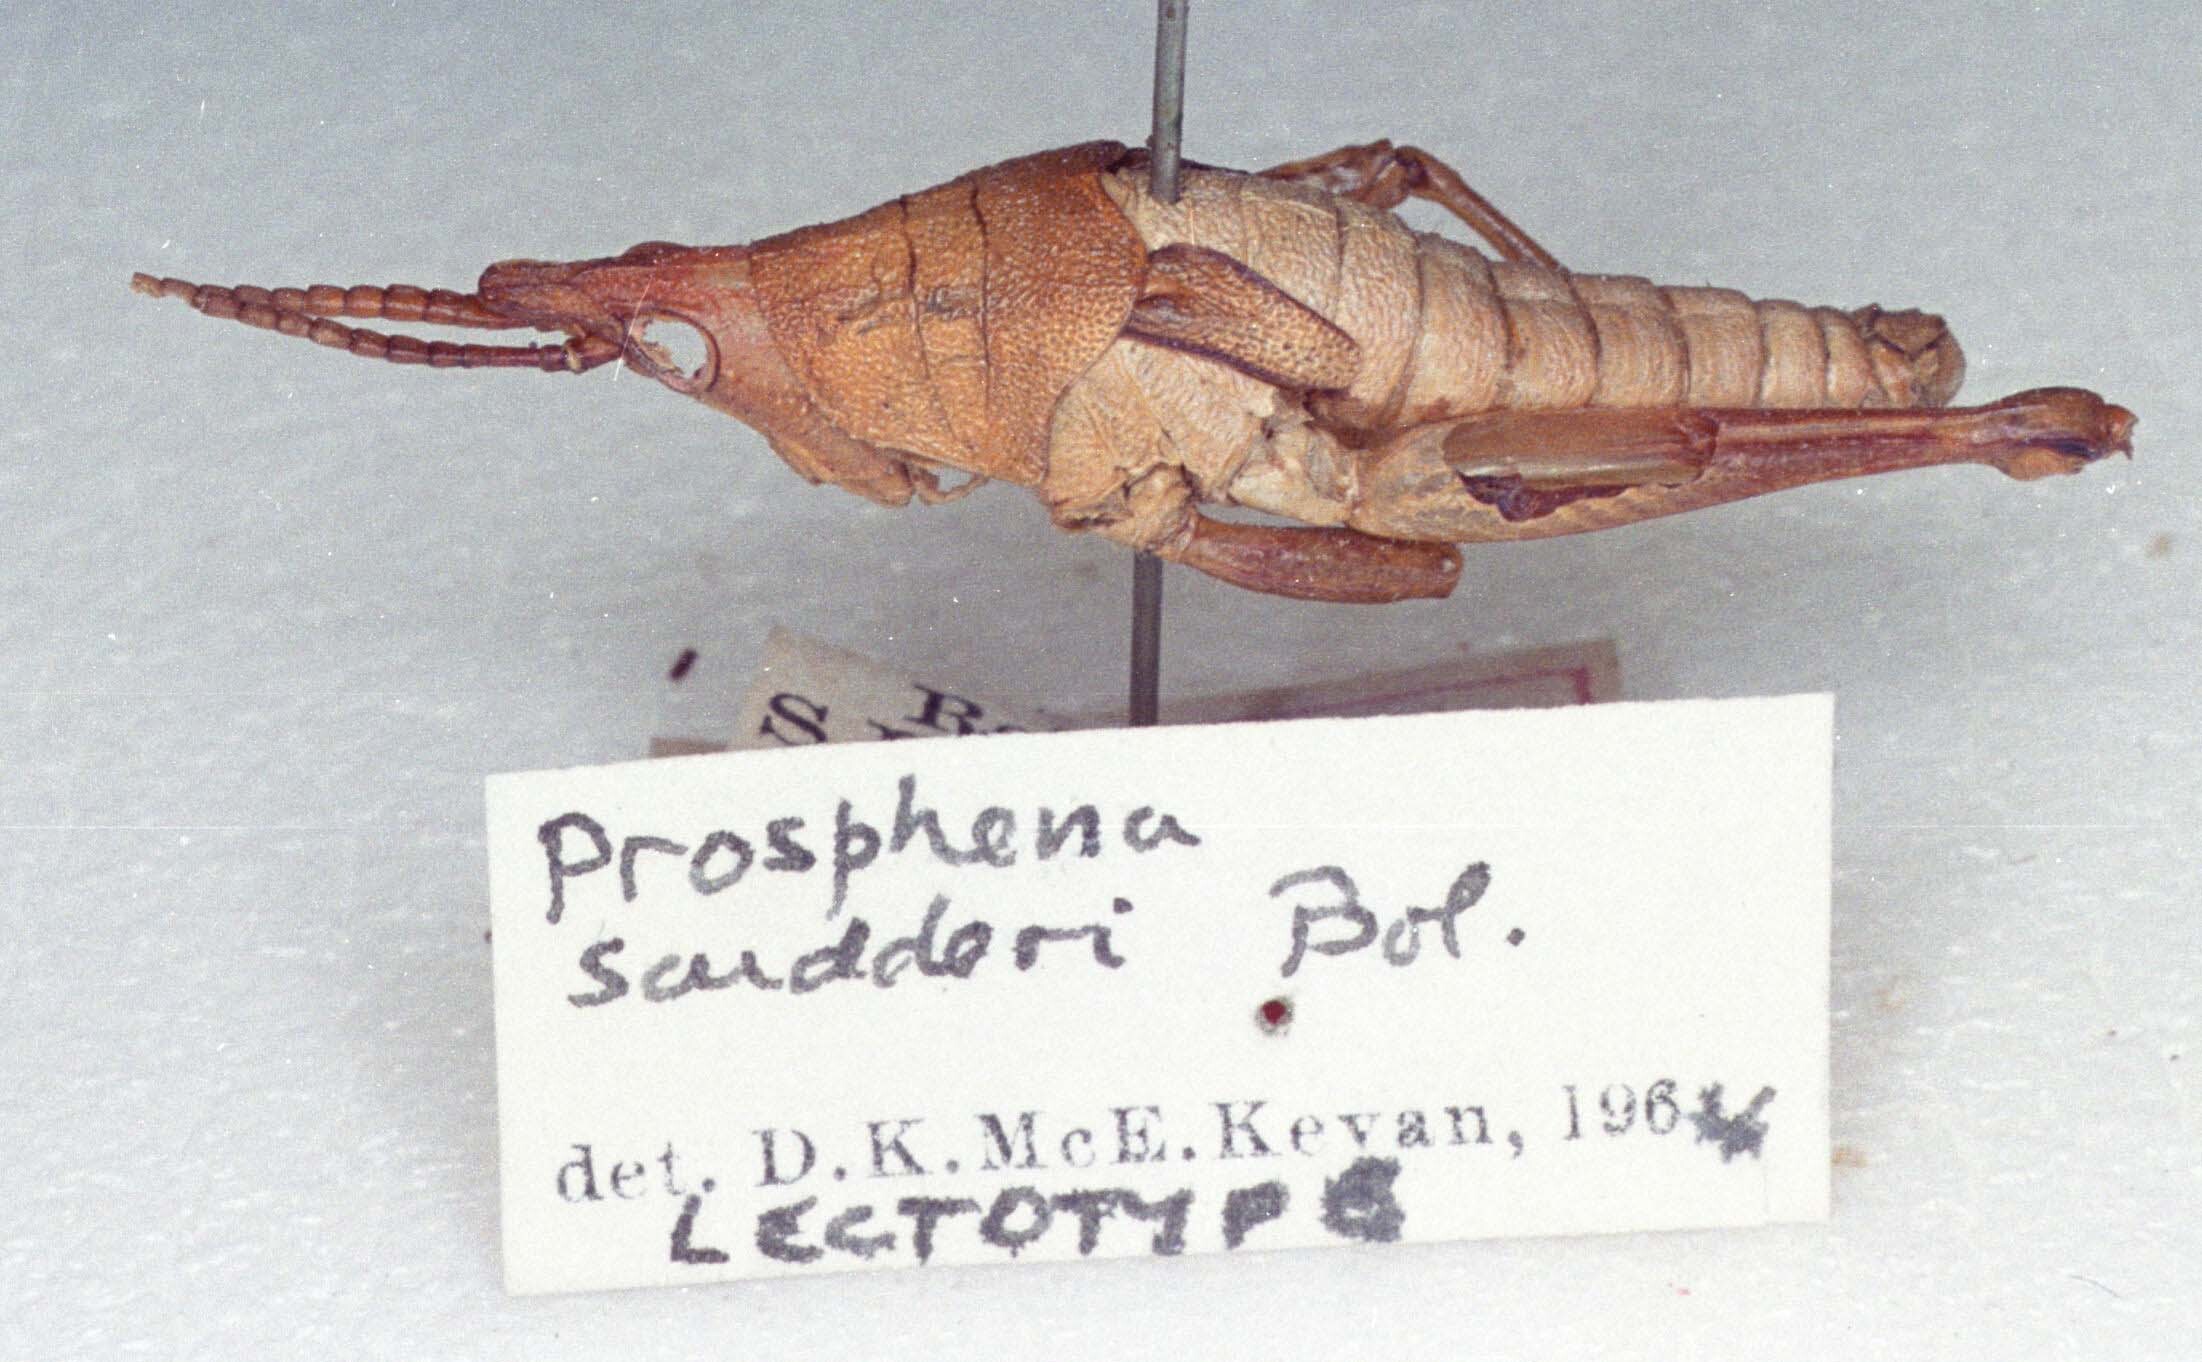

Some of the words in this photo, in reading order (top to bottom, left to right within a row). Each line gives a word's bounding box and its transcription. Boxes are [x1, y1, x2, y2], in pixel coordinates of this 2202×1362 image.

[536, 774, 1202, 925] Prosphena
[1269, 860, 1526, 978] Bol.
[556, 1143, 716, 1202] det.
[669, 1156, 1406, 1266] LECTOTYPE
